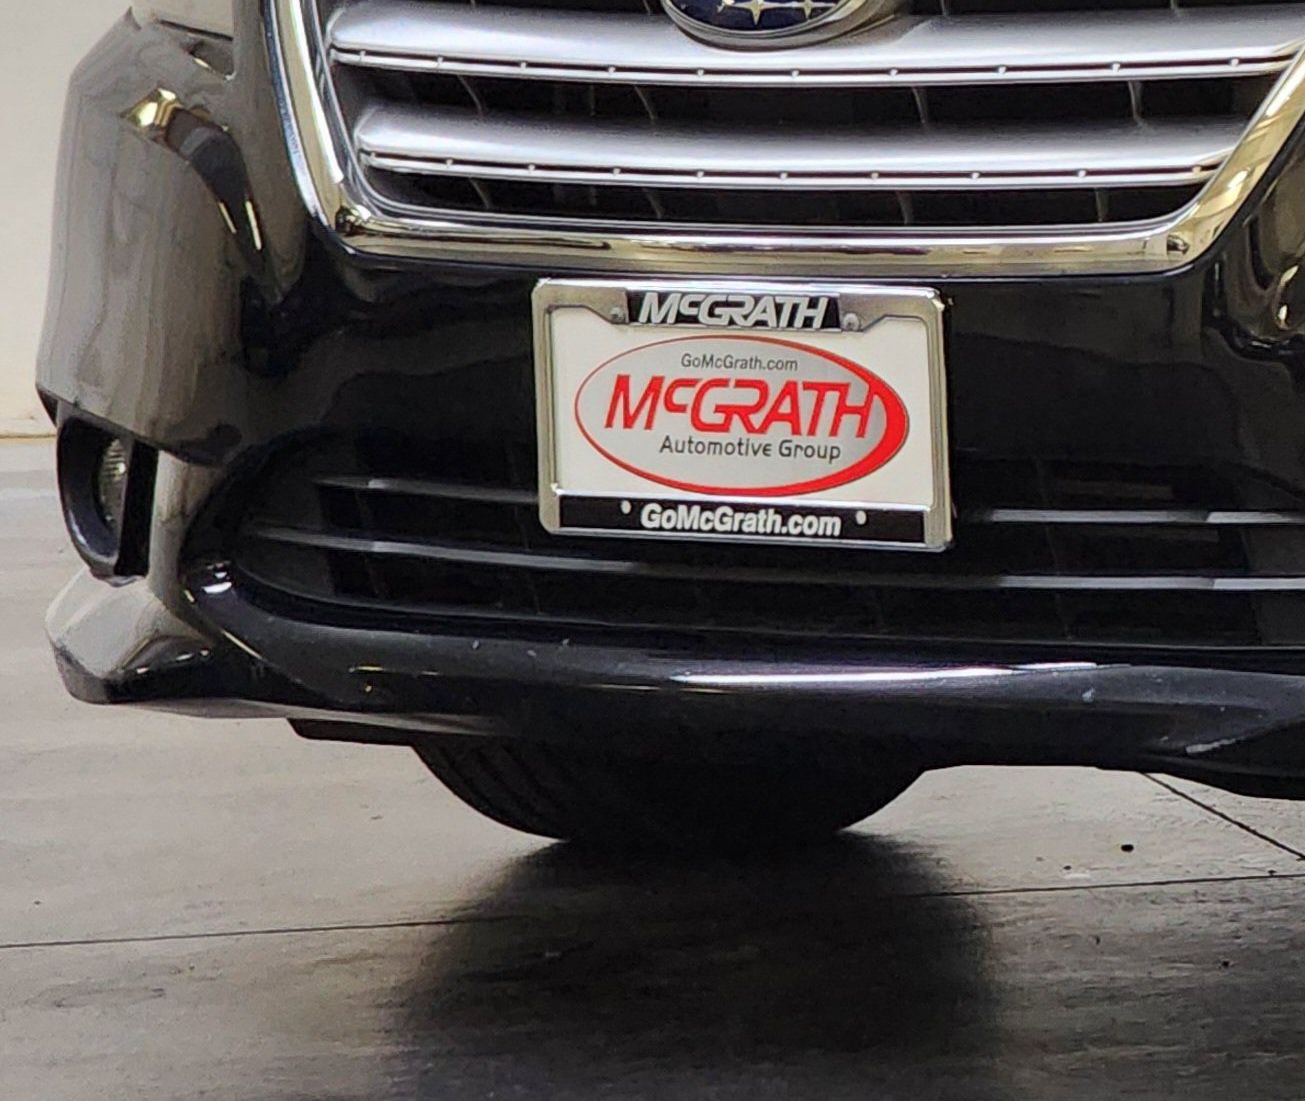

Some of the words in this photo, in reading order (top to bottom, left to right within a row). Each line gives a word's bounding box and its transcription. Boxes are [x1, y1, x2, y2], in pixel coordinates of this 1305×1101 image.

[680, 353, 799, 373] GoMcGrath.com
[658, 434, 773, 458] Automotive
[778, 439, 842, 465] Group
[640, 502, 842, 538] GoMcGrath.com
